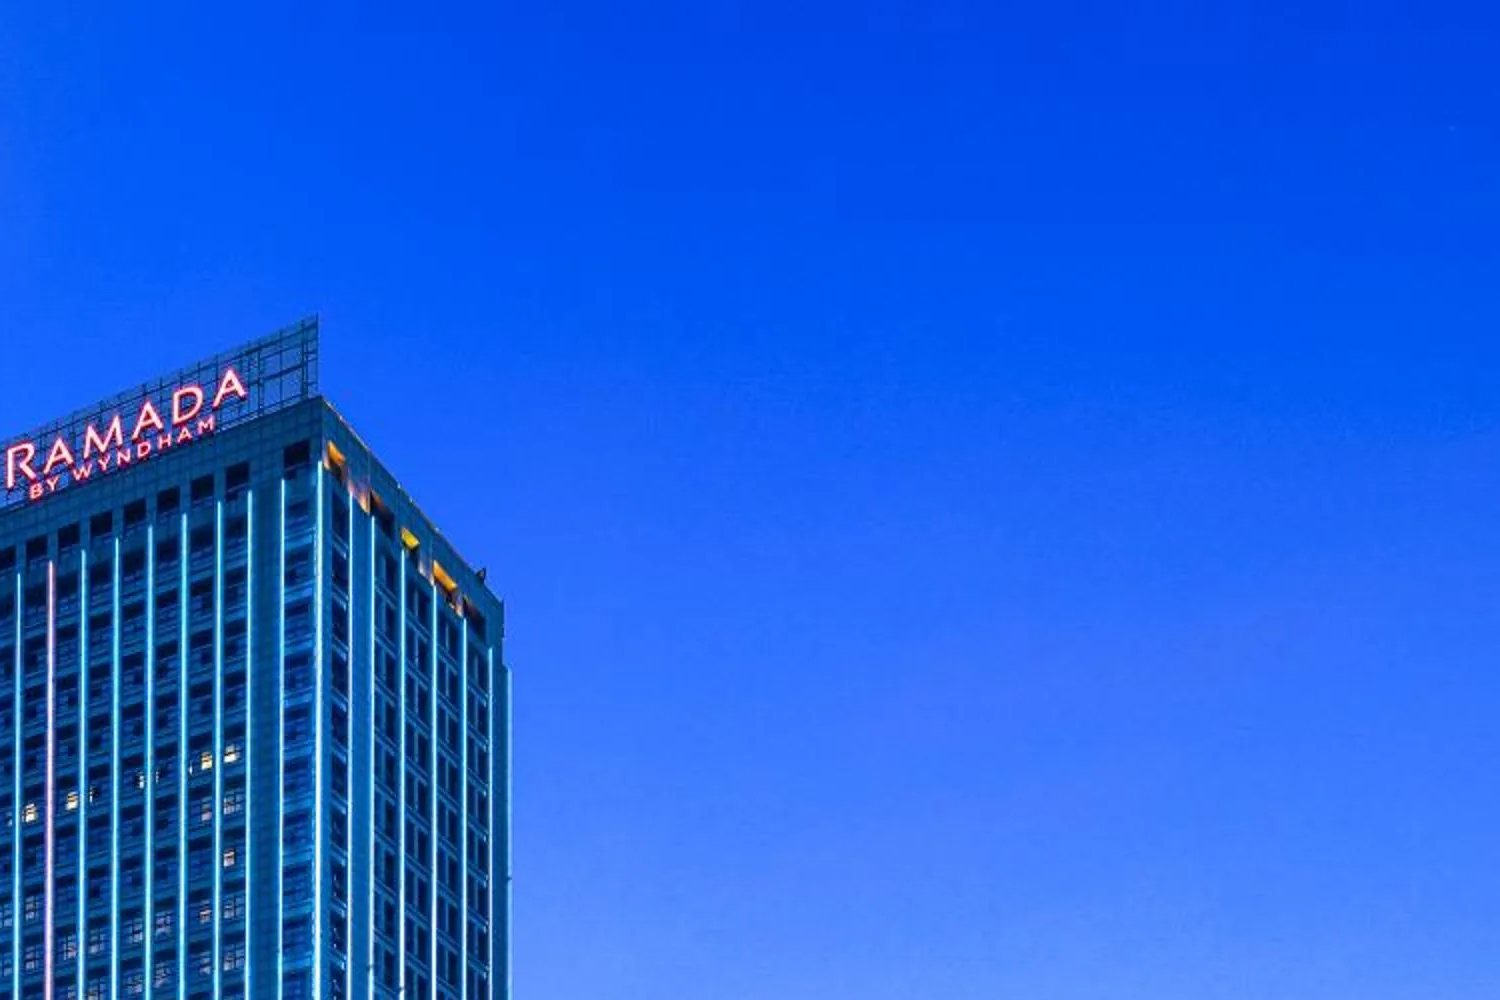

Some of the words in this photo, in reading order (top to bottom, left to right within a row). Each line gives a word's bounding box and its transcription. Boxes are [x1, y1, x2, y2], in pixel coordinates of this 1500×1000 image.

[4, 368, 248, 490] RAMADA
[28, 476, 60, 500] BY
[72, 414, 218, 482] WYNDHAM
